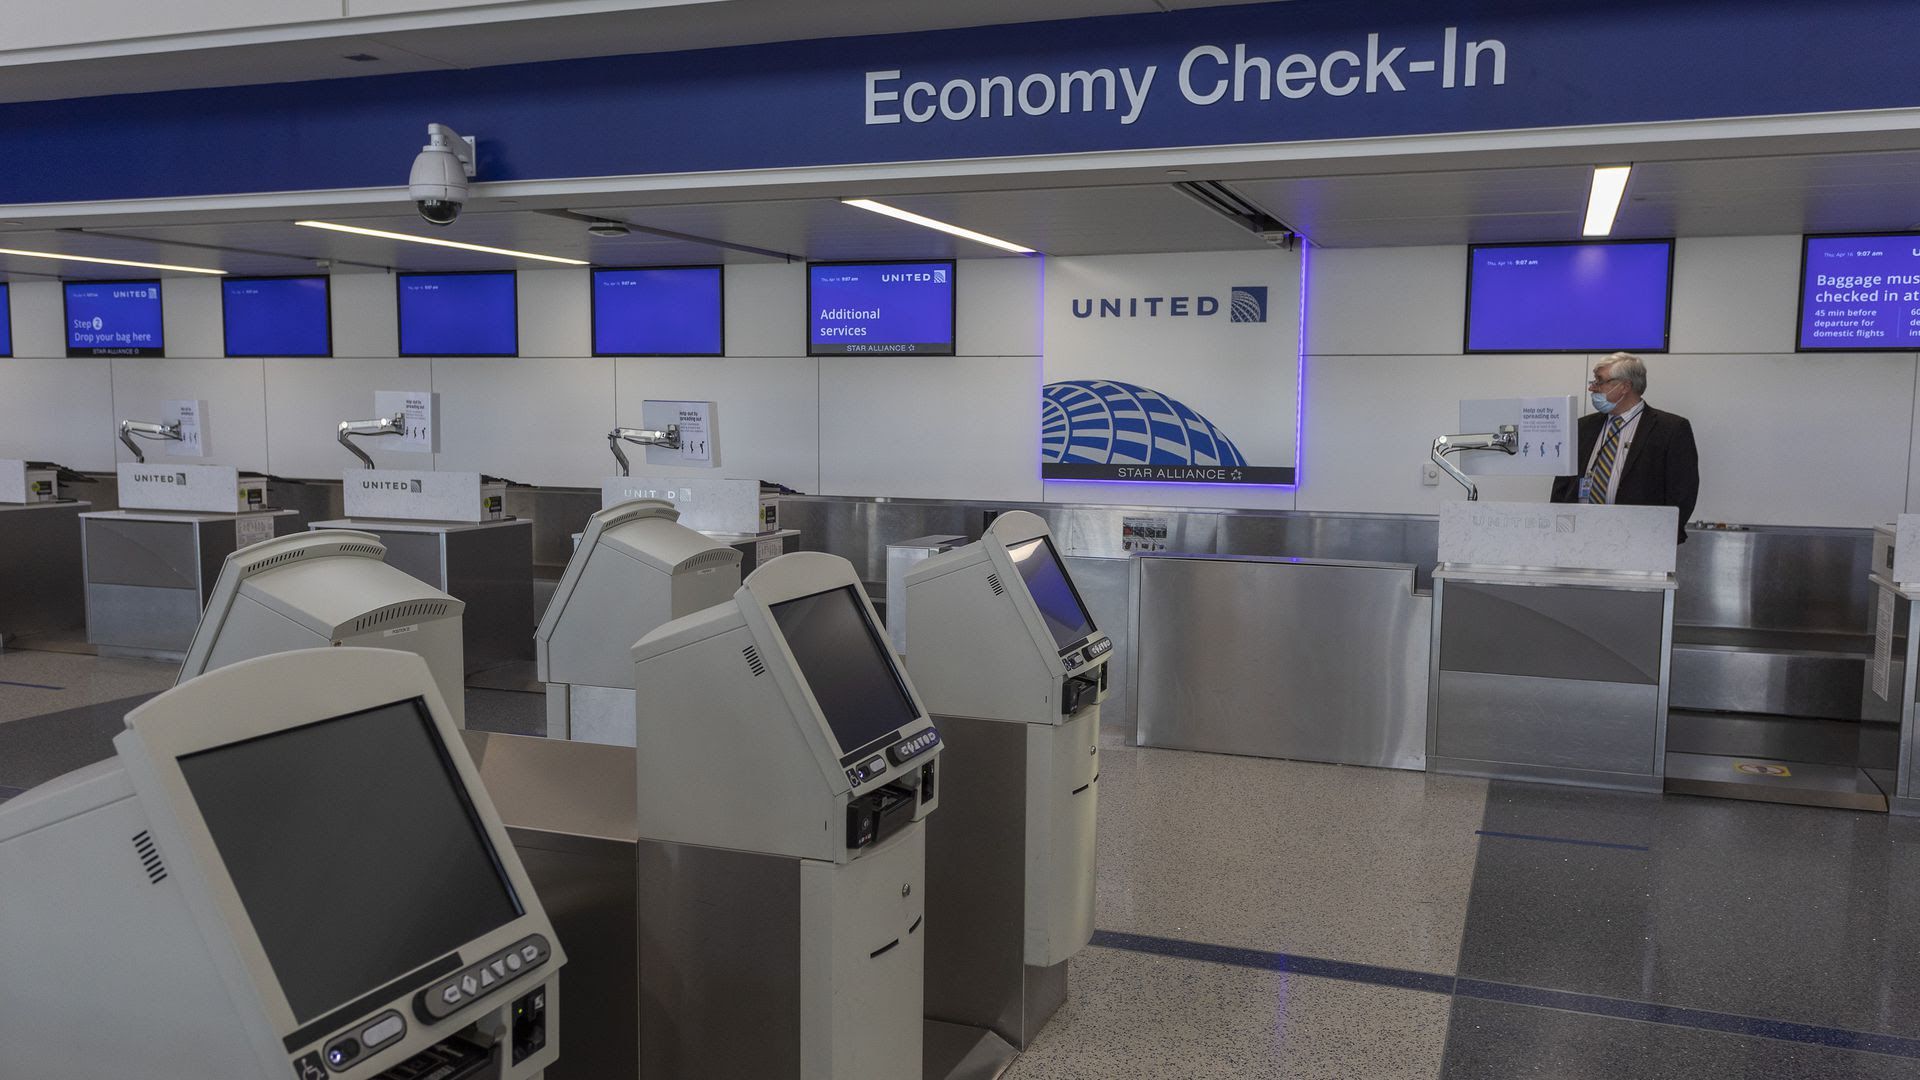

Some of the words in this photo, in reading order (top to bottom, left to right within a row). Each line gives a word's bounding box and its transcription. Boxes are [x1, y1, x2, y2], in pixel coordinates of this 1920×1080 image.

[865, 65, 1157, 125] Economy
[1178, 27, 1506, 105] Check-In
[881, 273, 931, 282] UNITED
[1817, 274, 1881, 288] Baggage
[1815, 290, 1878, 302] checked
[1884, 290, 1898, 301] in
[1903, 290, 1920, 301] at
[1072, 296, 1219, 318] UNITED
[820, 308, 880, 320] Additional
[73, 319, 91, 330] Step
[1814, 320, 1859, 328] departure
[820, 325, 867, 336] services
[1856, 329, 1885, 338] flights
[74, 332, 94, 343] Drop
[96, 333, 114, 343] your
[115, 332, 131, 344] bag
[132, 332, 151, 341] here
[134, 474, 174, 483] UNITED
[1118, 467, 1152, 478] STAR
[1157, 468, 1226, 479] ALLIANCE
[362, 481, 408, 490] UNITED
[624, 489, 676, 499] UNITD
